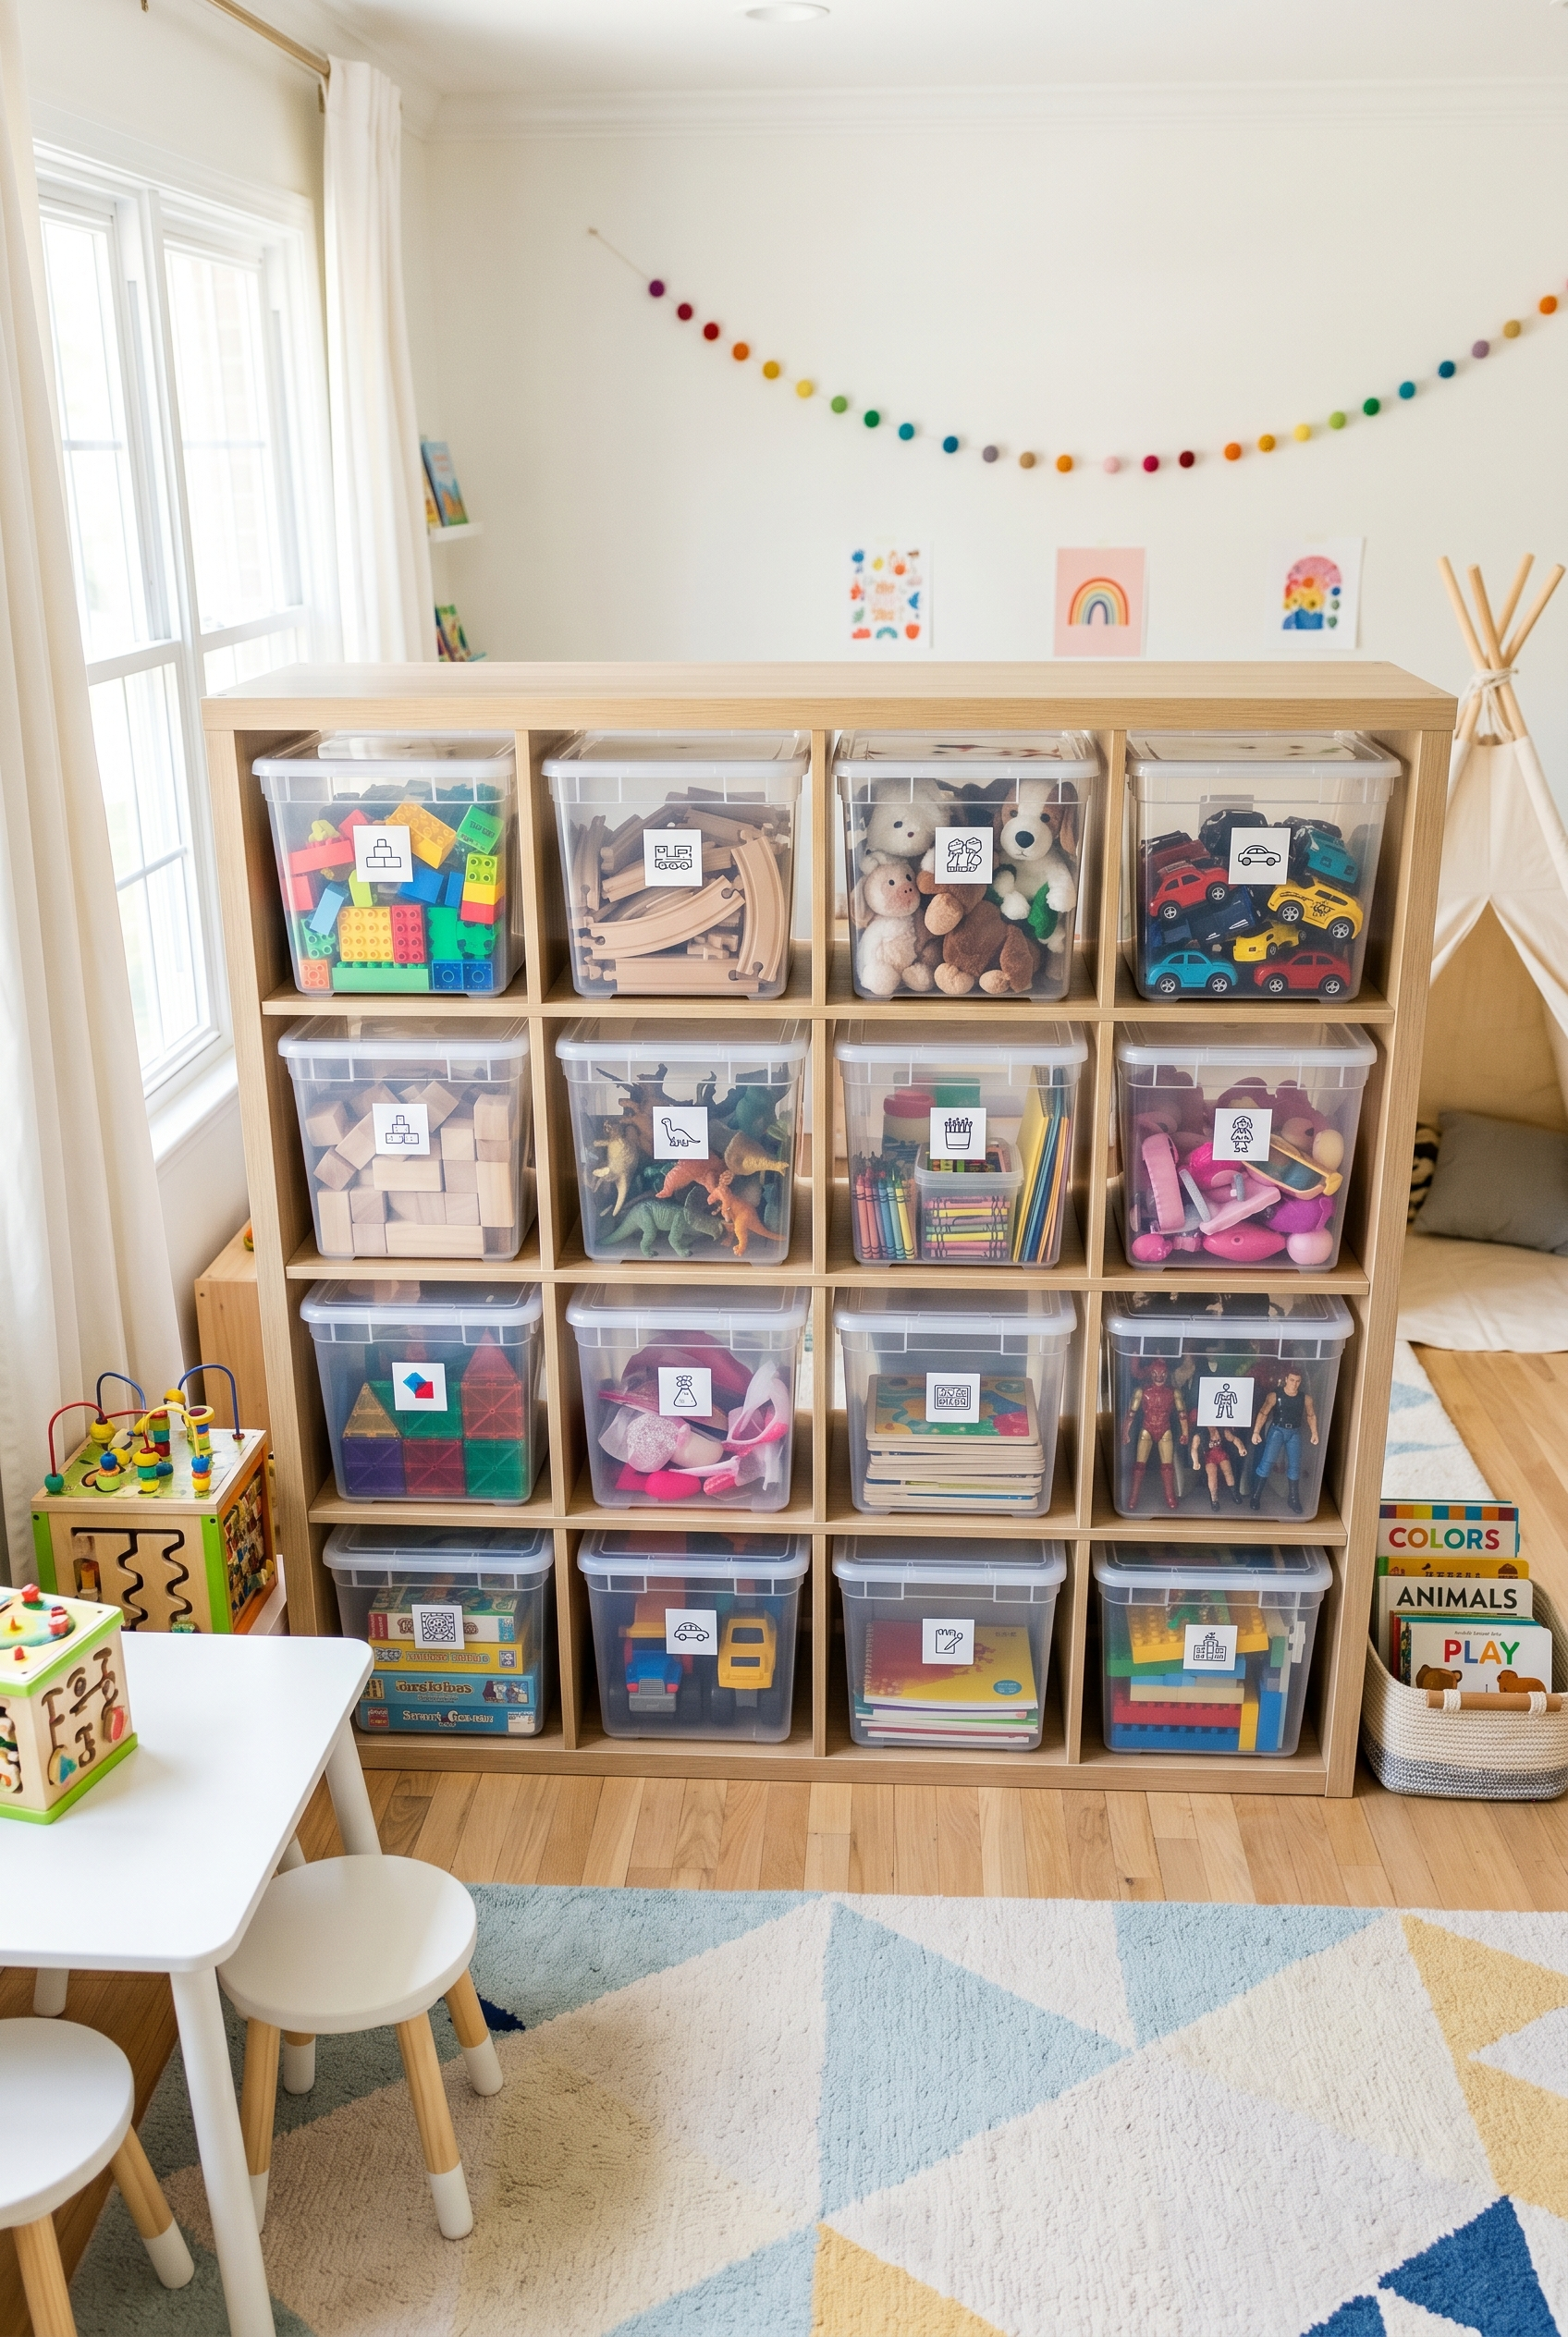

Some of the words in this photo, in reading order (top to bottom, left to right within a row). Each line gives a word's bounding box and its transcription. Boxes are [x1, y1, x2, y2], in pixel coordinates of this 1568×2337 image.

[1389, 1527, 1500, 1549] COLORS
[1396, 1585, 1517, 1609] ANIMALS
[1444, 1639, 1520, 1665] PLAY
